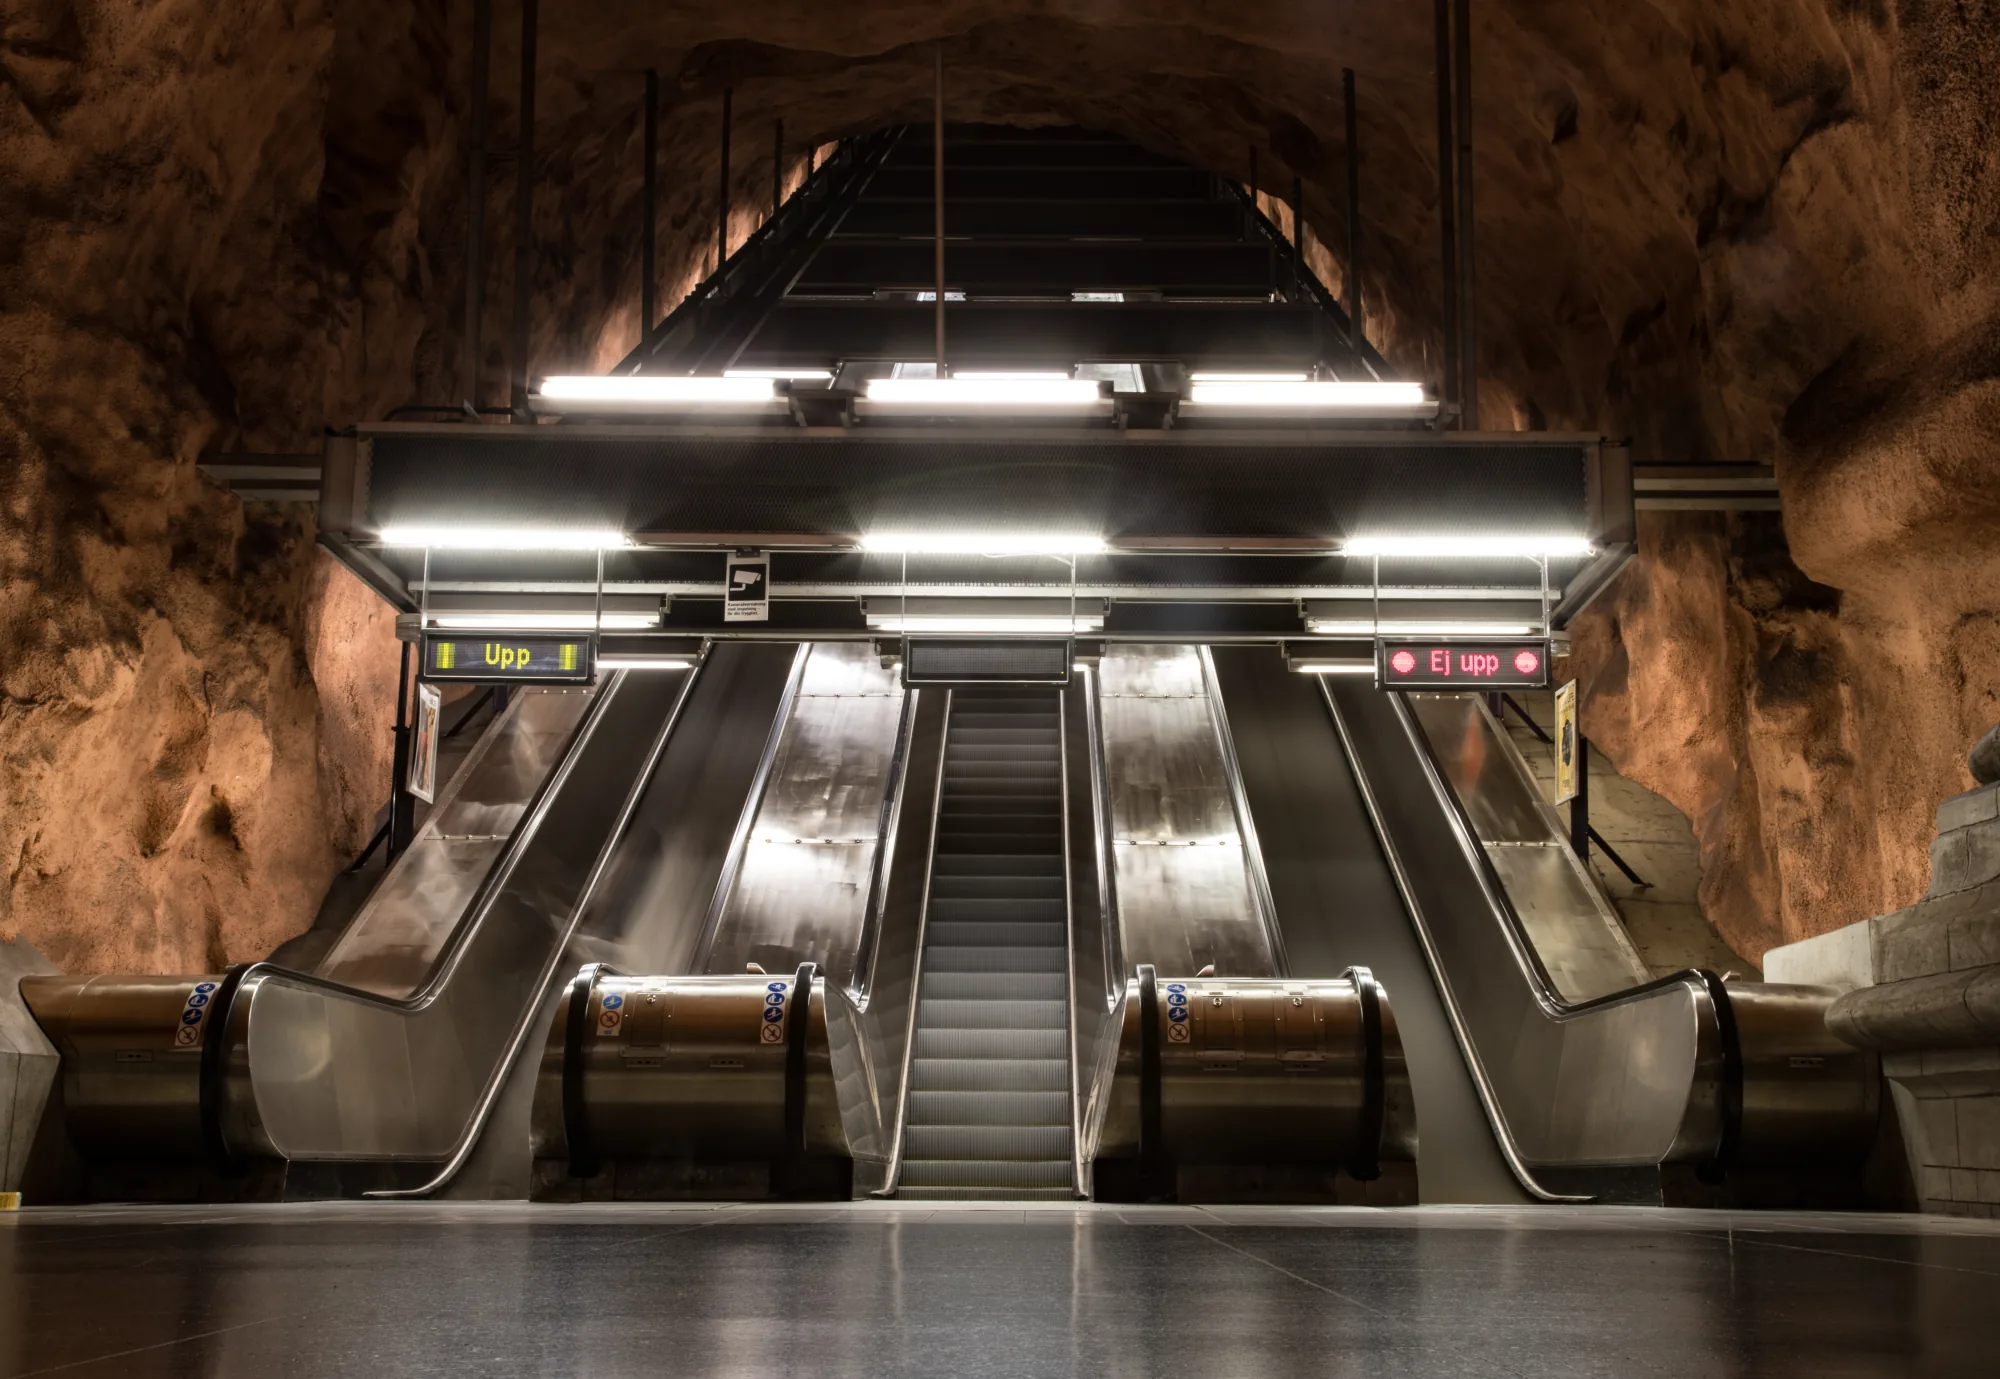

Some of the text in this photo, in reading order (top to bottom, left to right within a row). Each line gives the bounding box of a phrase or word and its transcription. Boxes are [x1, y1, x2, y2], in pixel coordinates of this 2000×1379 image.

[485, 643, 530, 670] Upp
[1430, 649, 1500, 677] Ej upp
